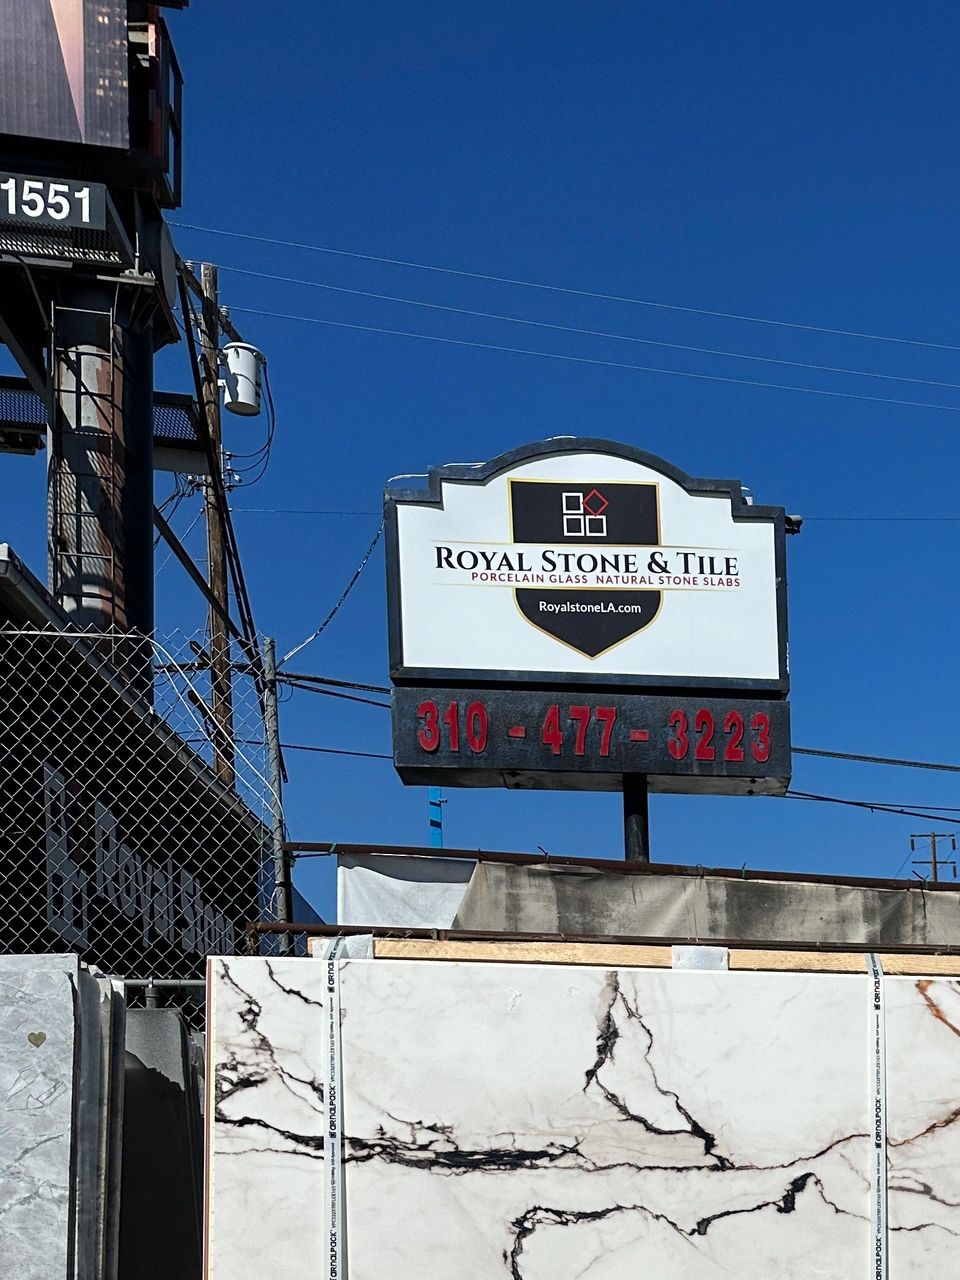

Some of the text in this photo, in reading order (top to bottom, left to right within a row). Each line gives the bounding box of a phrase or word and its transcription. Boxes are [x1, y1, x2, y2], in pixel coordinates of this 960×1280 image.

[0, 177, 90, 223] 1551
[435, 546, 740, 576] ROYAL STONE & TILE
[471, 572, 741, 587] PORCELAIN GLASS NATURAL STONE SLABS
[539, 600, 642, 615] RoyalstoneLA.com
[417, 700, 488, 754] 310
[541, 705, 617, 757] 477
[668, 710, 771, 764] 3223
